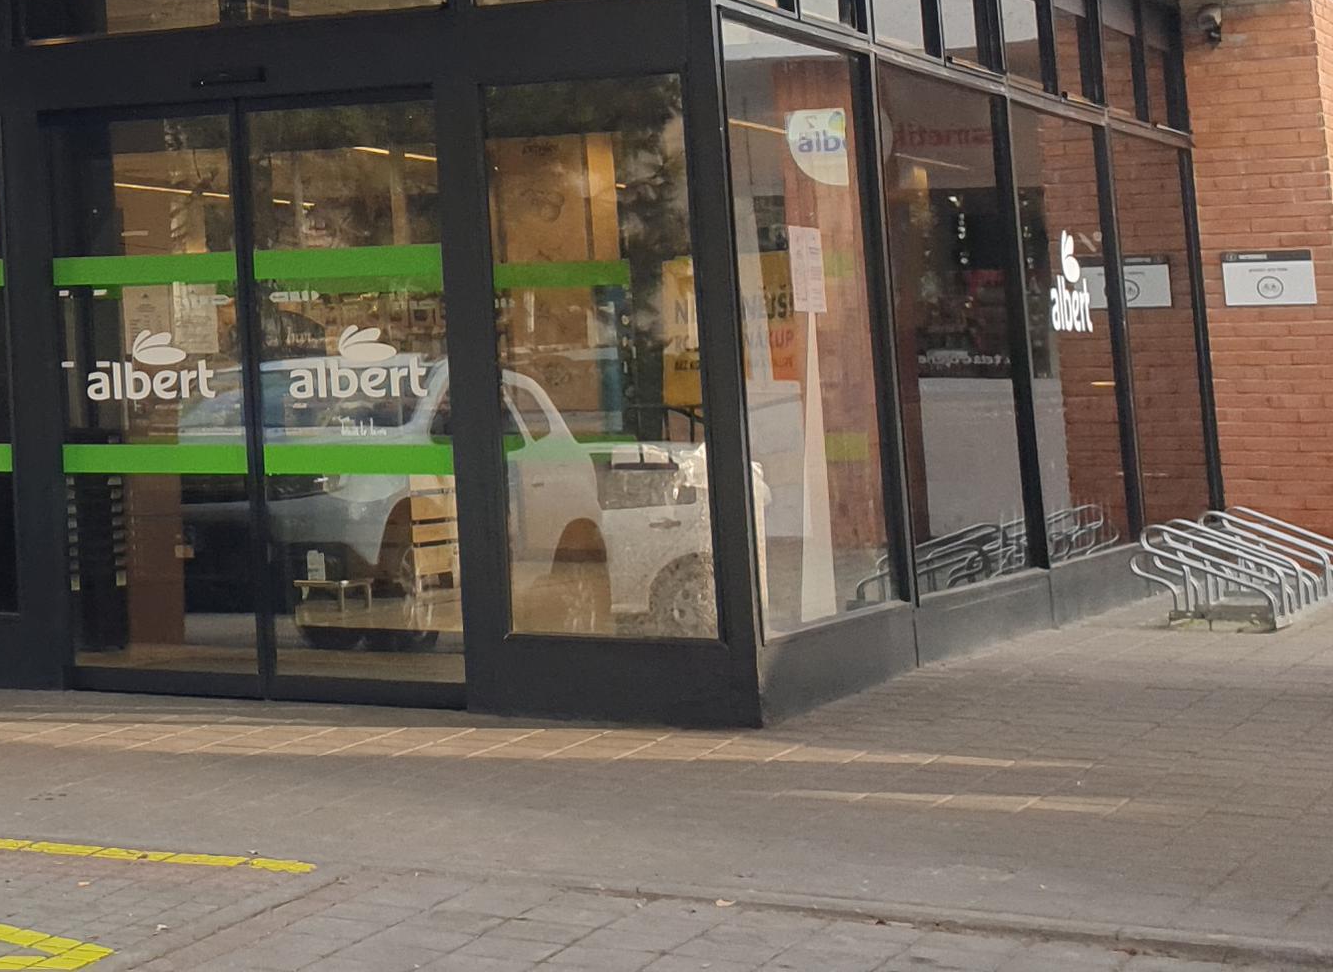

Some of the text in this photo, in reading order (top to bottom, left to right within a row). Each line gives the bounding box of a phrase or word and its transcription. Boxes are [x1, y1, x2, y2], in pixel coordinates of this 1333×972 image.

[1050, 274, 1093, 332] albert
[87, 361, 216, 400] albert
[289, 357, 429, 399] albert
